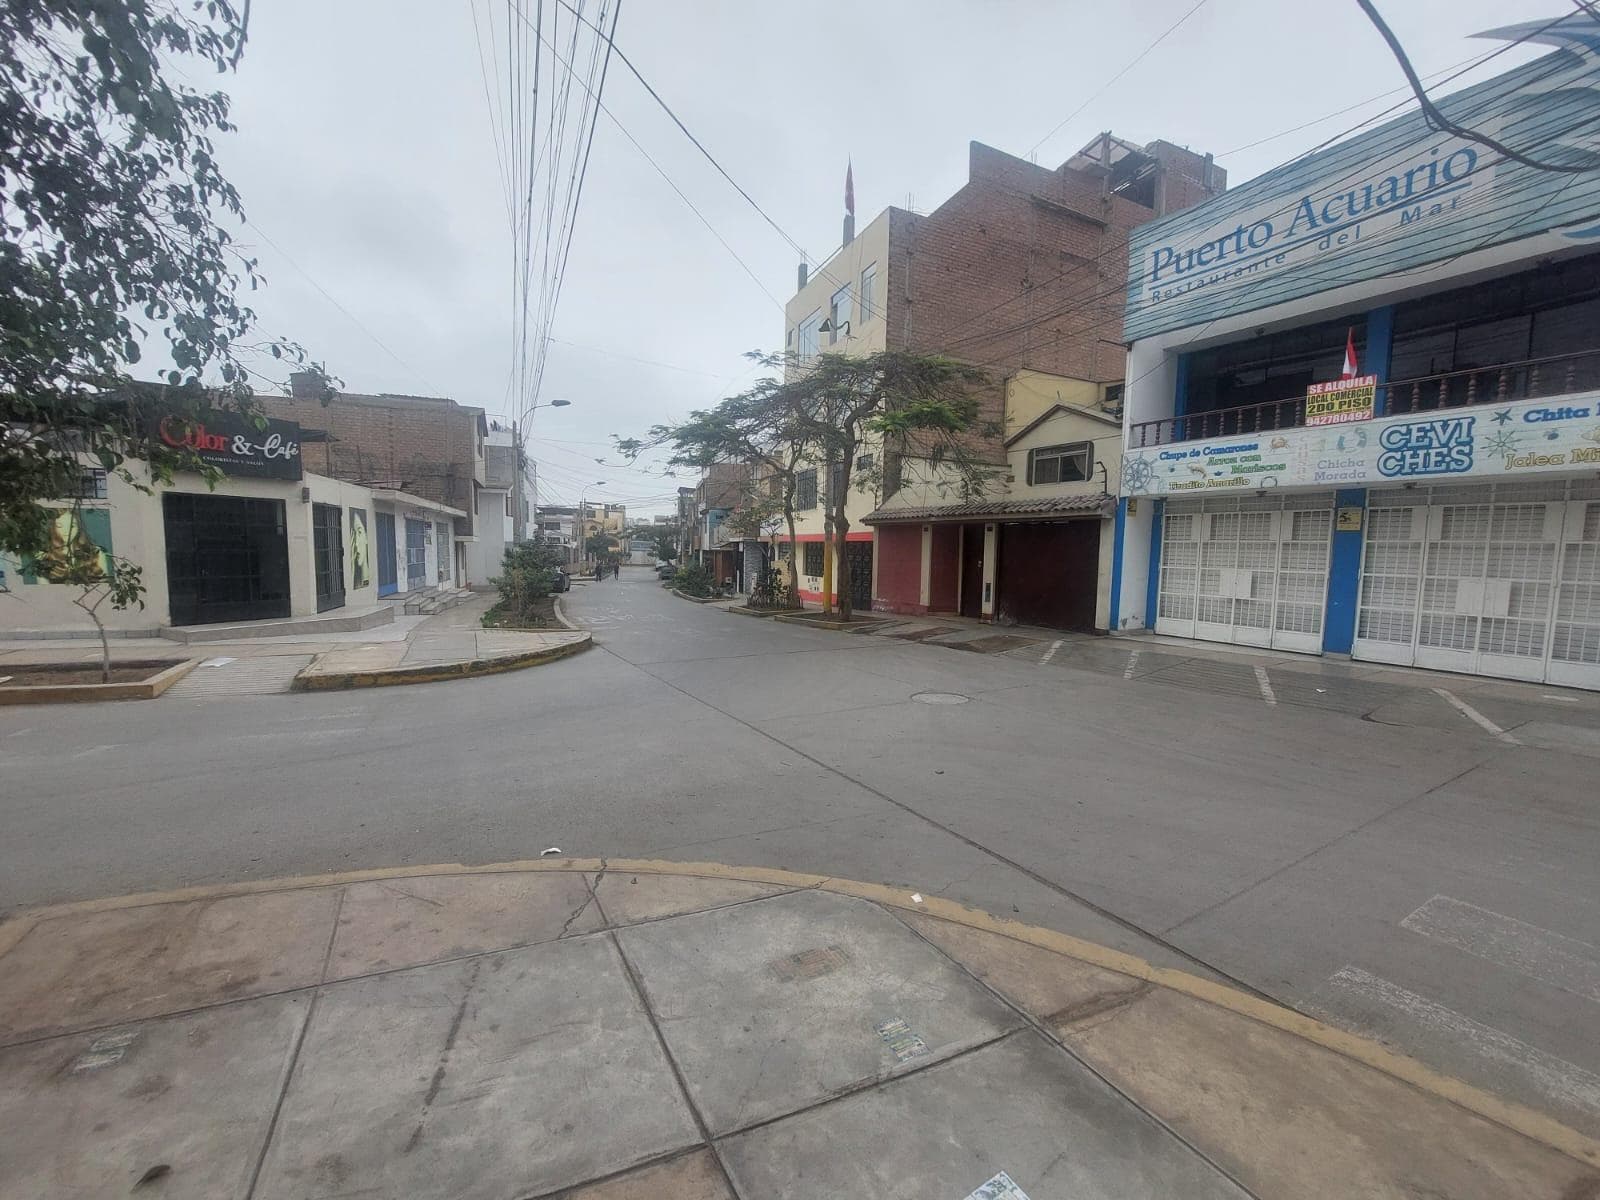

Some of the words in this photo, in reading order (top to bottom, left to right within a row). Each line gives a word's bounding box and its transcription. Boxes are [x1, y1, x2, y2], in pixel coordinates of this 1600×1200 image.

[1151, 220, 1273, 283] Puerto
[1287, 146, 1478, 238] Acuario
[1151, 250, 1287, 302] Restaurante
[1319, 226, 1361, 251] del
[1400, 195, 1464, 225] Mar
[1310, 384, 1323, 395] SE
[1325, 375, 1374, 392] ALQUILA
[1308, 392, 1330, 405] LOCAL
[1331, 386, 1374, 402] COMERCIAL
[1308, 402, 1335, 414] 2DO
[1338, 396, 1372, 410] PISO
[1523, 406, 1590, 423] Chita
[1379, 416, 1477, 450] CEVI
[231, 434, 255, 456] &
[1189, 448, 1201, 458] de
[1202, 443, 1259, 456] Camarones
[1231, 463, 1287, 474] Mariscos
[1317, 457, 1365, 469] Chicha
[1377, 444, 1474, 478] CHES
[1504, 451, 1566, 471] Jalea
[1206, 477, 1250, 488] Amarillo
[1314, 469, 1367, 481] Morada
